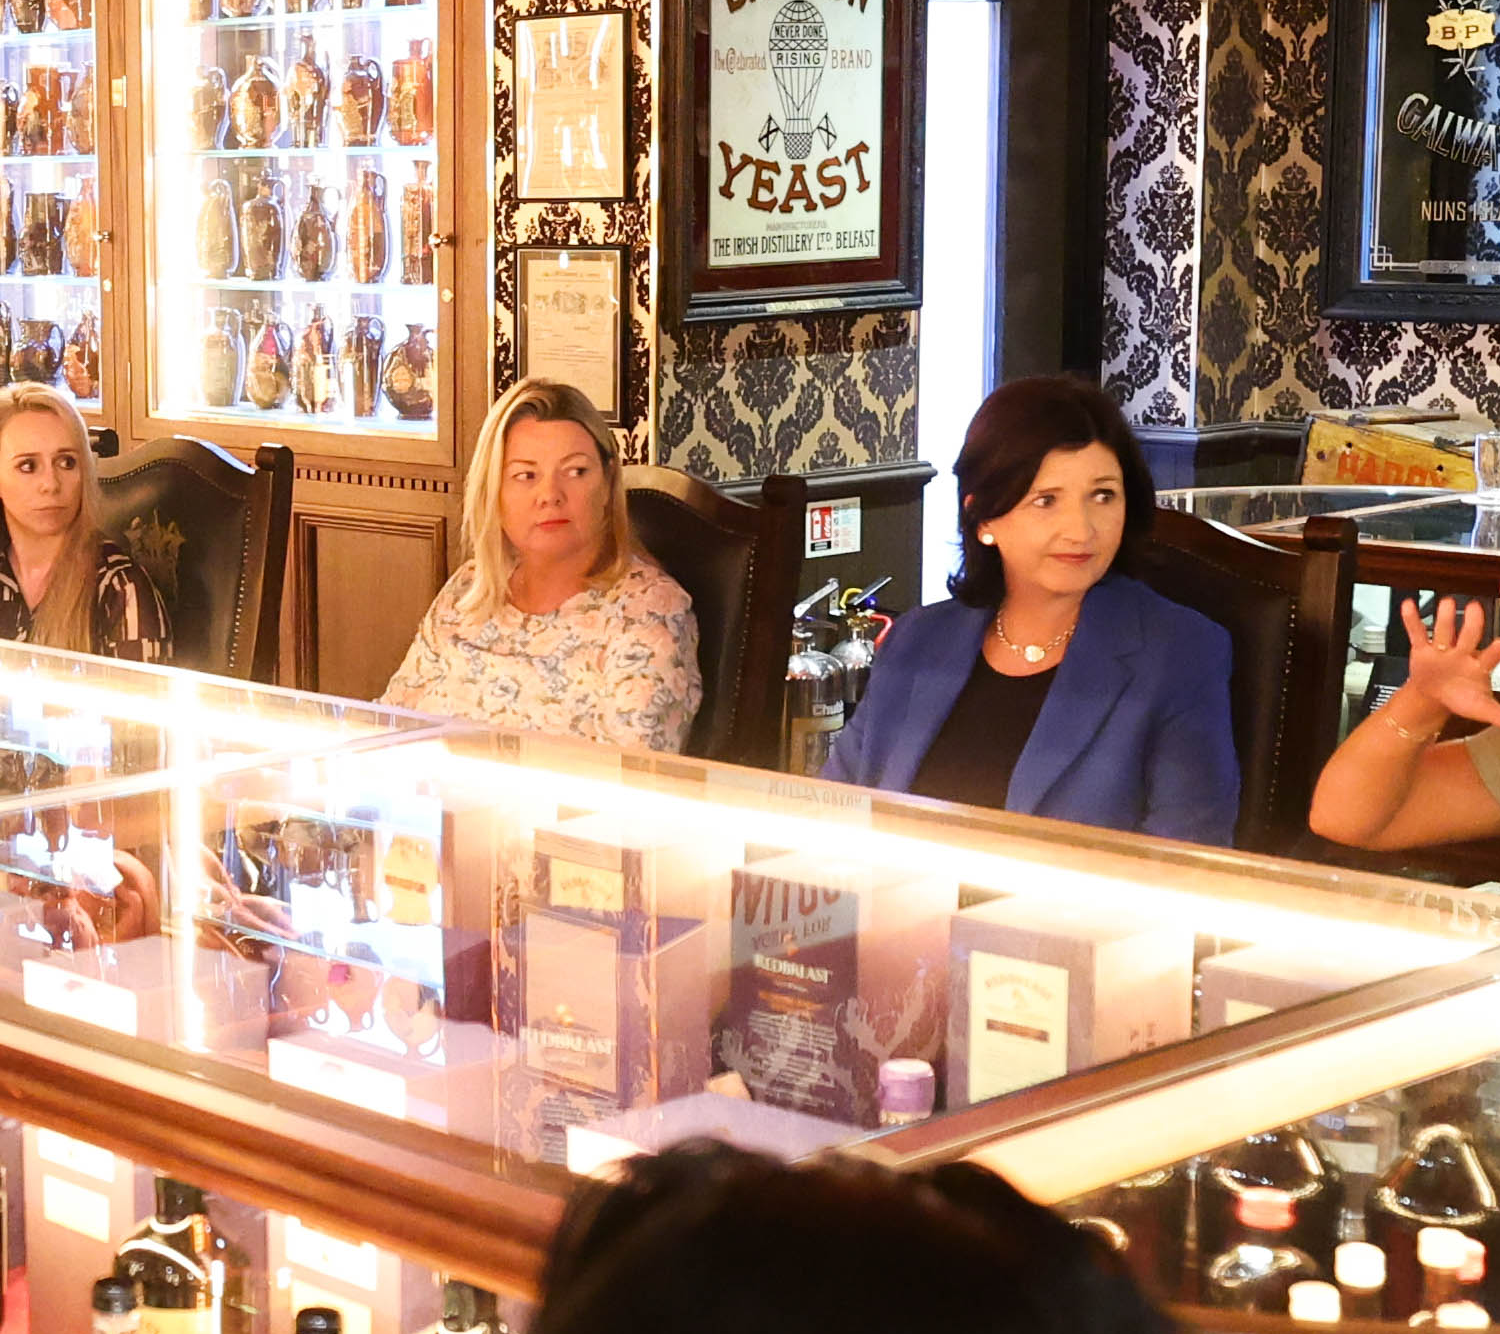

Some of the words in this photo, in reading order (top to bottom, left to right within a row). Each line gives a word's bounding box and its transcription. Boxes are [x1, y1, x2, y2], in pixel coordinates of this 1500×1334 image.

[775, 25, 800, 38] NEVER
[803, 25, 823, 38] DONE
[777, 53, 820, 65] RISING
[832, 49, 872, 69] BRAND
[718, 141, 870, 213] YEAST
[1421, 201, 1466, 221] NUNS
[713, 238, 731, 257] THE
[734, 236, 758, 255] IRISH
[761, 233, 813, 254] DISTILLERY
